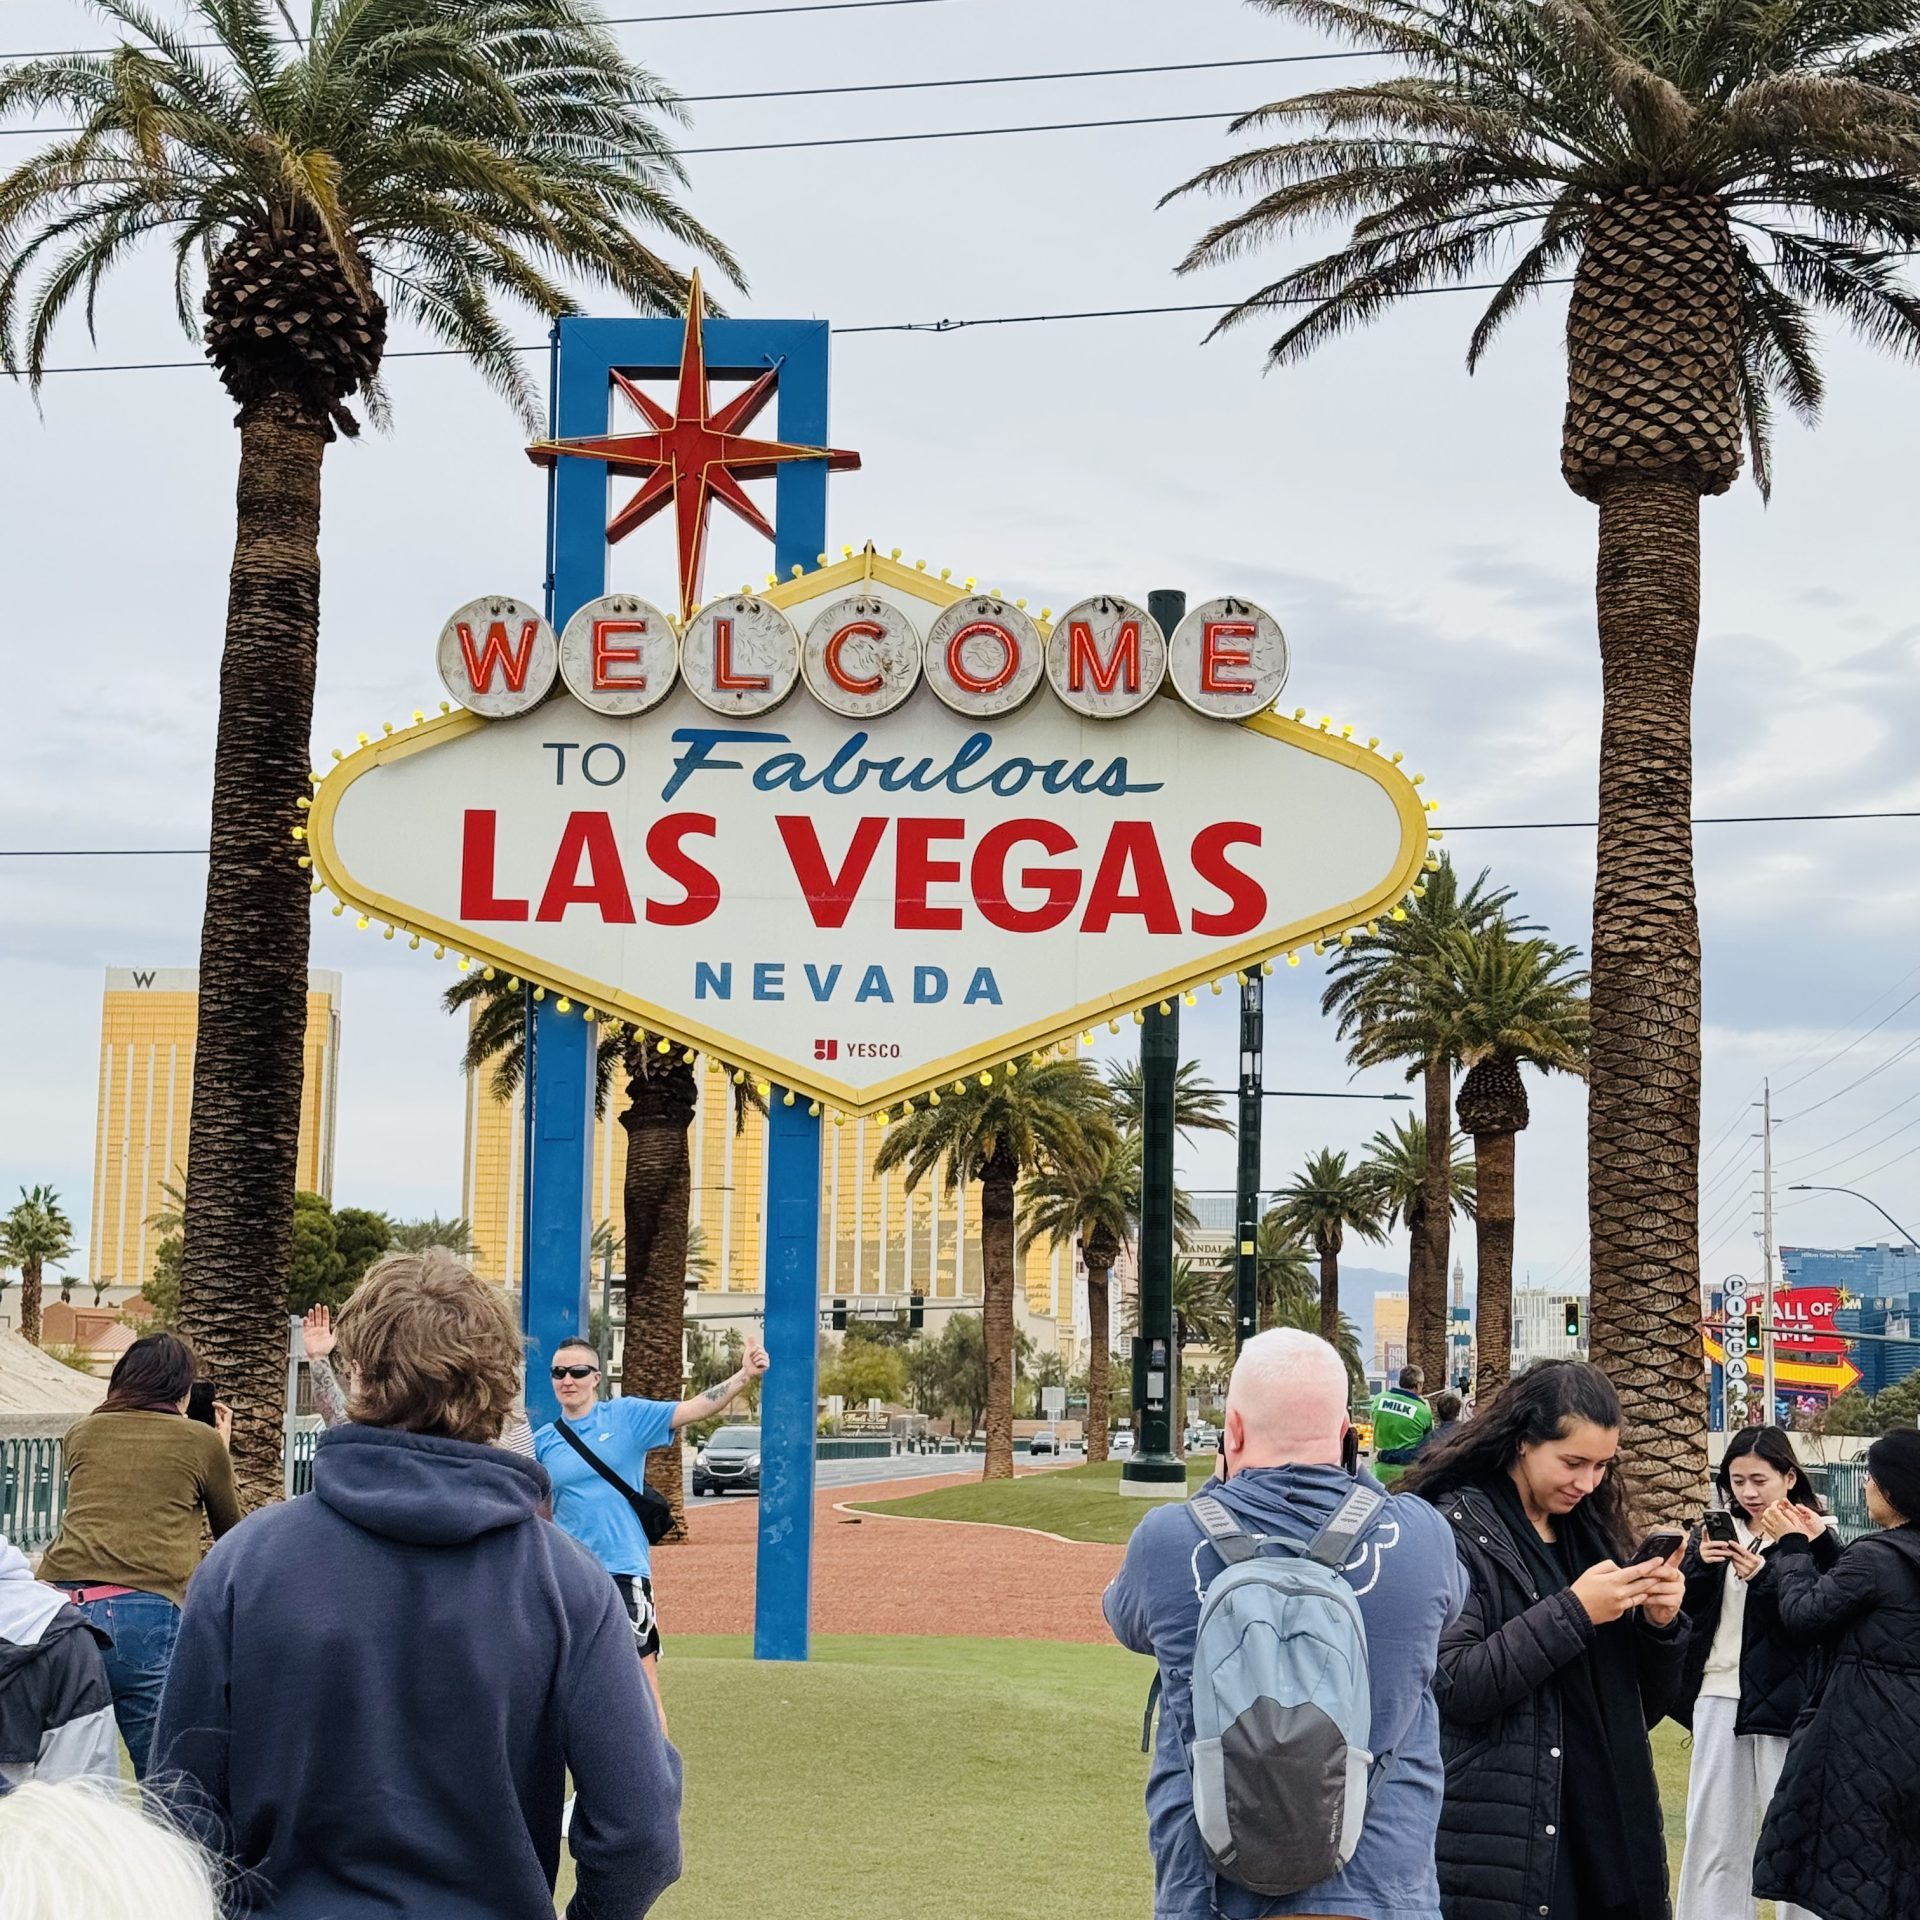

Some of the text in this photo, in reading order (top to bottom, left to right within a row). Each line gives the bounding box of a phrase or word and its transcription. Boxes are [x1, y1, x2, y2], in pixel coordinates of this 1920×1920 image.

[456, 619, 1256, 696] WELCOME
[544, 728, 1161, 802] TO Fabulous
[460, 809, 1267, 937] LAS VEGAS
[132, 971, 156, 989] W
[695, 962, 1002, 1005] NEVADA
[847, 1043, 900, 1058] YESCO
[1179, 1244, 1235, 1253] MANDAL
[1810, 1302, 1833, 1316] OF
[1381, 1399, 1412, 1415] MILK
